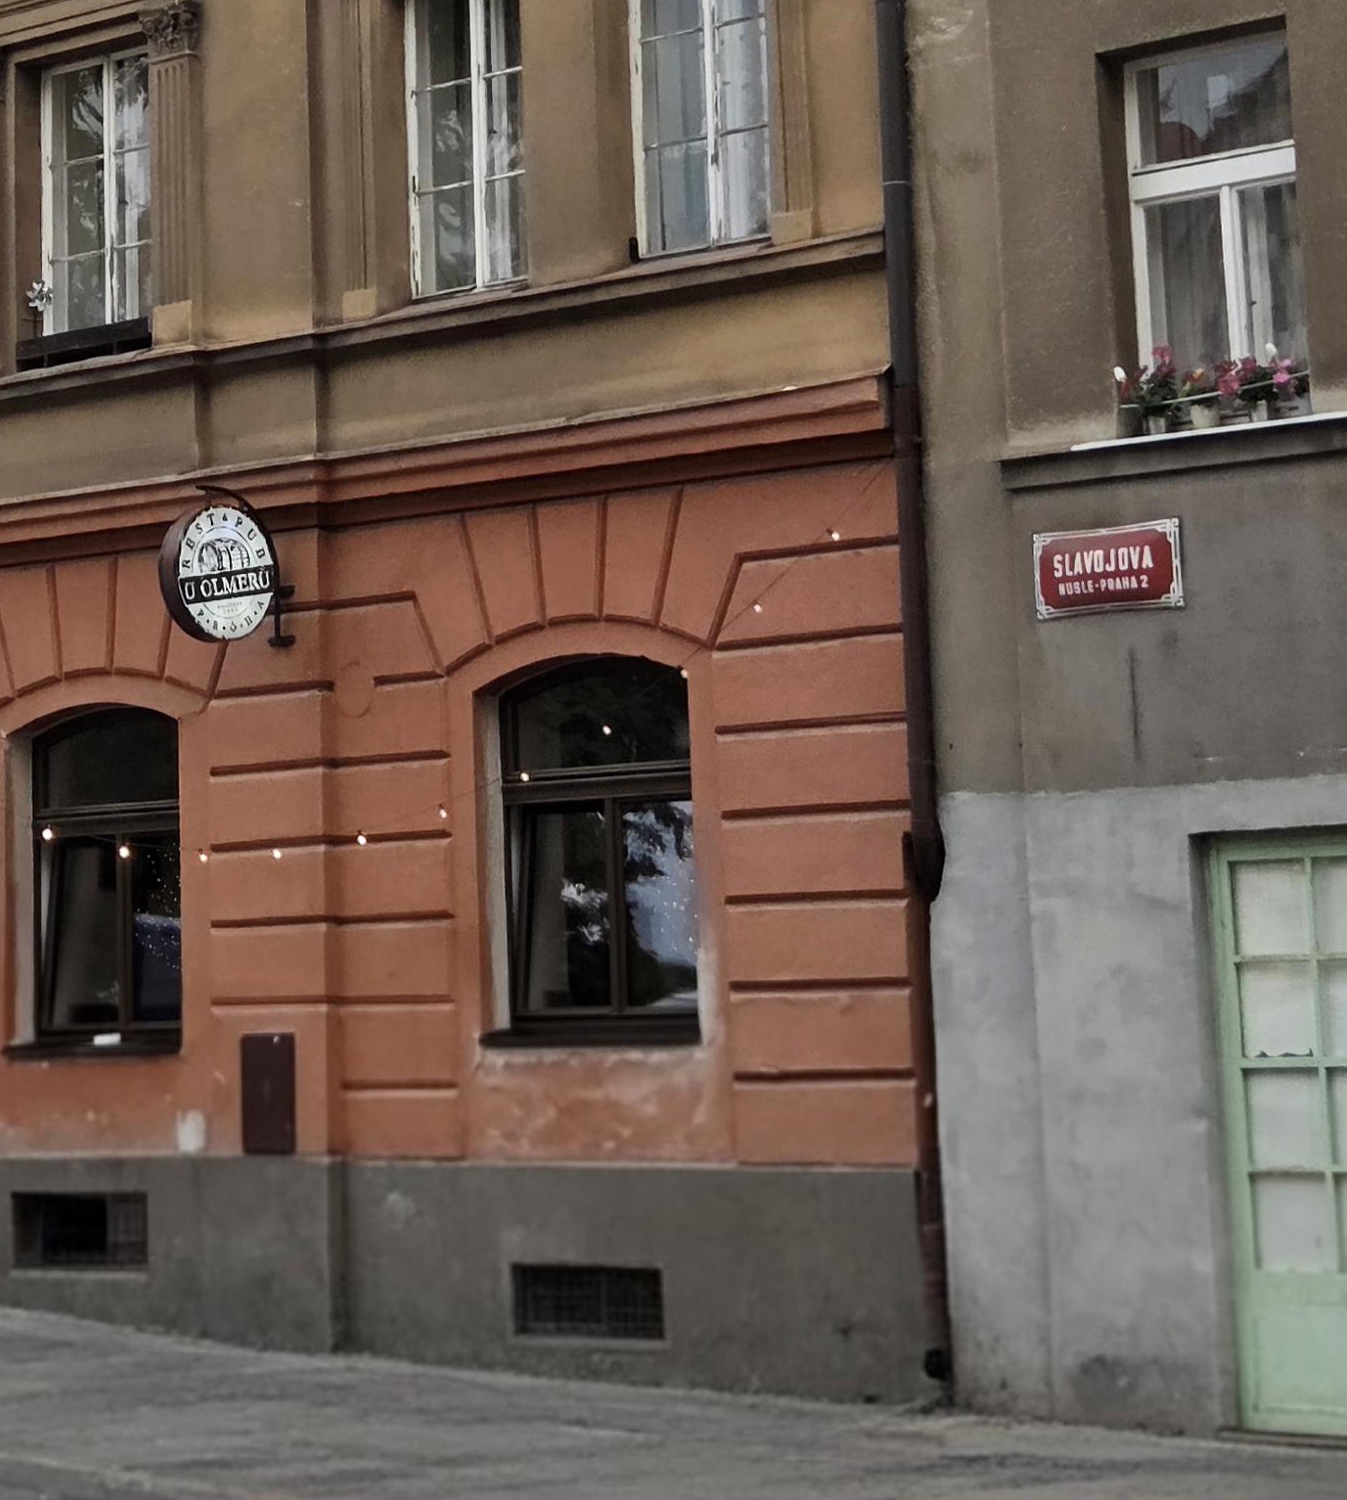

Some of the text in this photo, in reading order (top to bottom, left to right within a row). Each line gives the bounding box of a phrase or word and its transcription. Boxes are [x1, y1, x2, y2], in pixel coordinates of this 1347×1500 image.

[1053, 545, 1154, 578] SLAVOJOVA
[184, 581, 196, 600] U
[1101, 576, 1138, 591] PRAHA
[1140, 575, 1150, 588] 2
